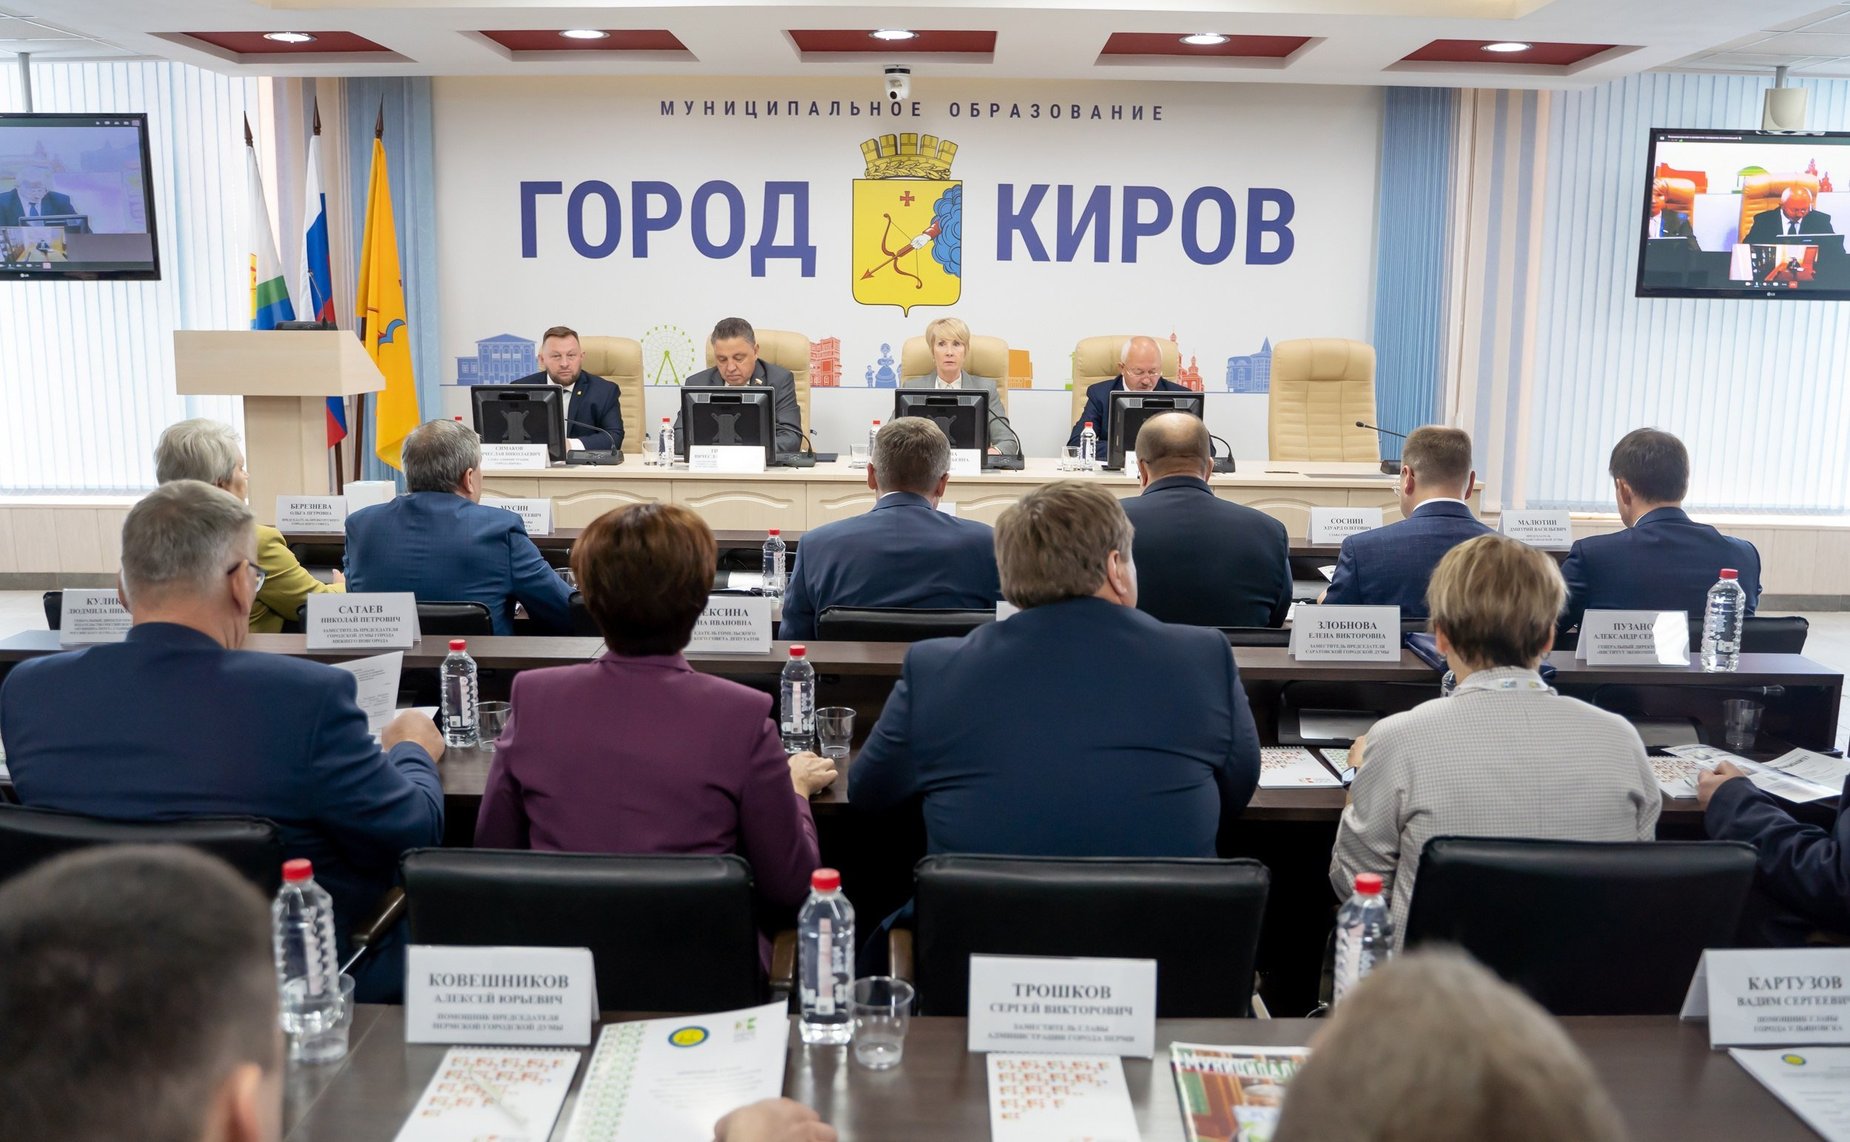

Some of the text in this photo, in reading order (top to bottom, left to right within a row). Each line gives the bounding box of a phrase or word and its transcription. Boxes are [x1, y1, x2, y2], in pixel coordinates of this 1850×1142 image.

[660, 100, 1163, 121] МУНИЦИПАЛЬНОЕ ОБРАЗОВАНИЕ
[519, 180, 1297, 278] ГОРОД КИРОВ
[338, 605, 384, 614] САТАЕВ
[702, 608, 749, 617] ЕКСИНА
[1318, 621, 1377, 630] ЗЛОБНОВА
[1614, 623, 1654, 631] ПУЗАНО
[429, 973, 569, 989] КОВЕШНИКОВ
[1747, 976, 1843, 991] КАРТУЗОВ
[1013, 983, 1112, 1000] ТРОШКОВ
[434, 992, 563, 1005] АЛЕКСЕЙ ЮРЬЕВИЧ
[1737, 996, 1782, 1008] ВАДИМ
[989, 1002, 1134, 1016] СЕРГЕЙ ВИКТОРОВИЧ
